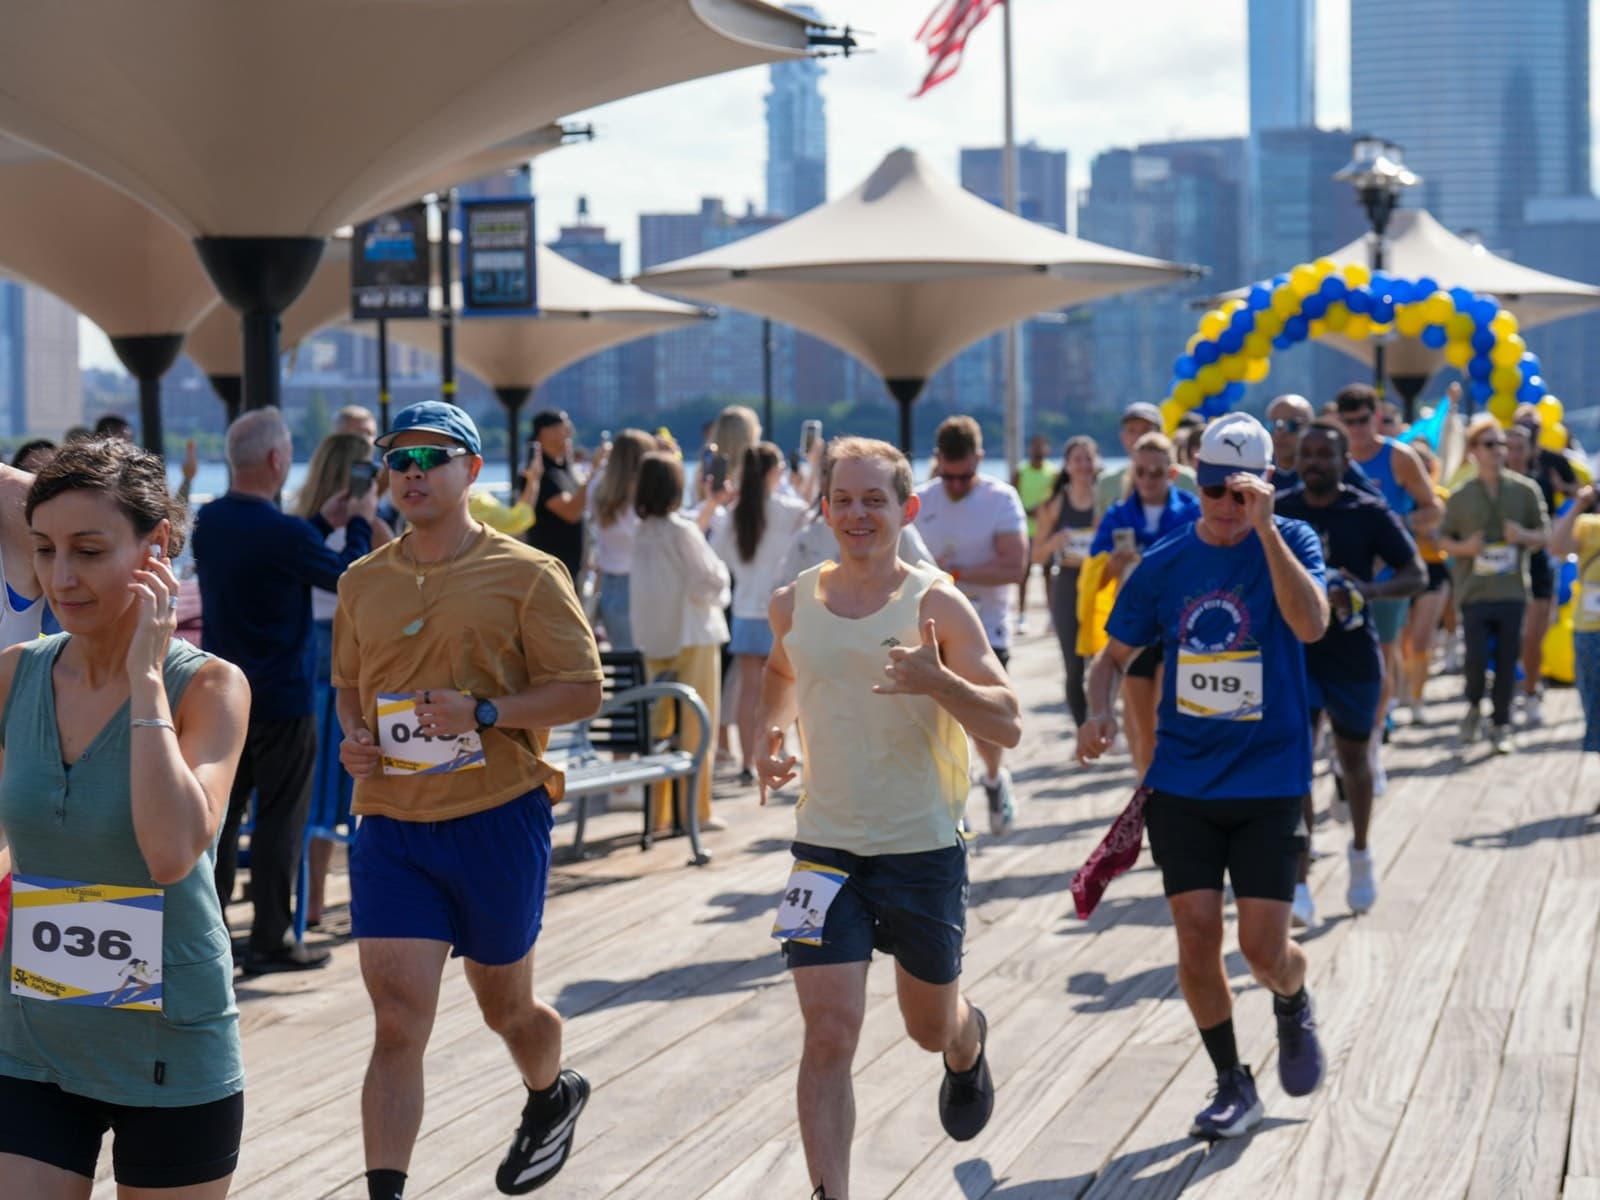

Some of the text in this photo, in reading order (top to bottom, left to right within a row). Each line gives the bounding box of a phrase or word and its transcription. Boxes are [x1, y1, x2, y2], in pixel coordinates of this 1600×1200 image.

[1191, 673, 1241, 693] 019
[391, 723, 458, 743] 04
[786, 887, 813, 909] 41
[32, 921, 132, 960] 036
